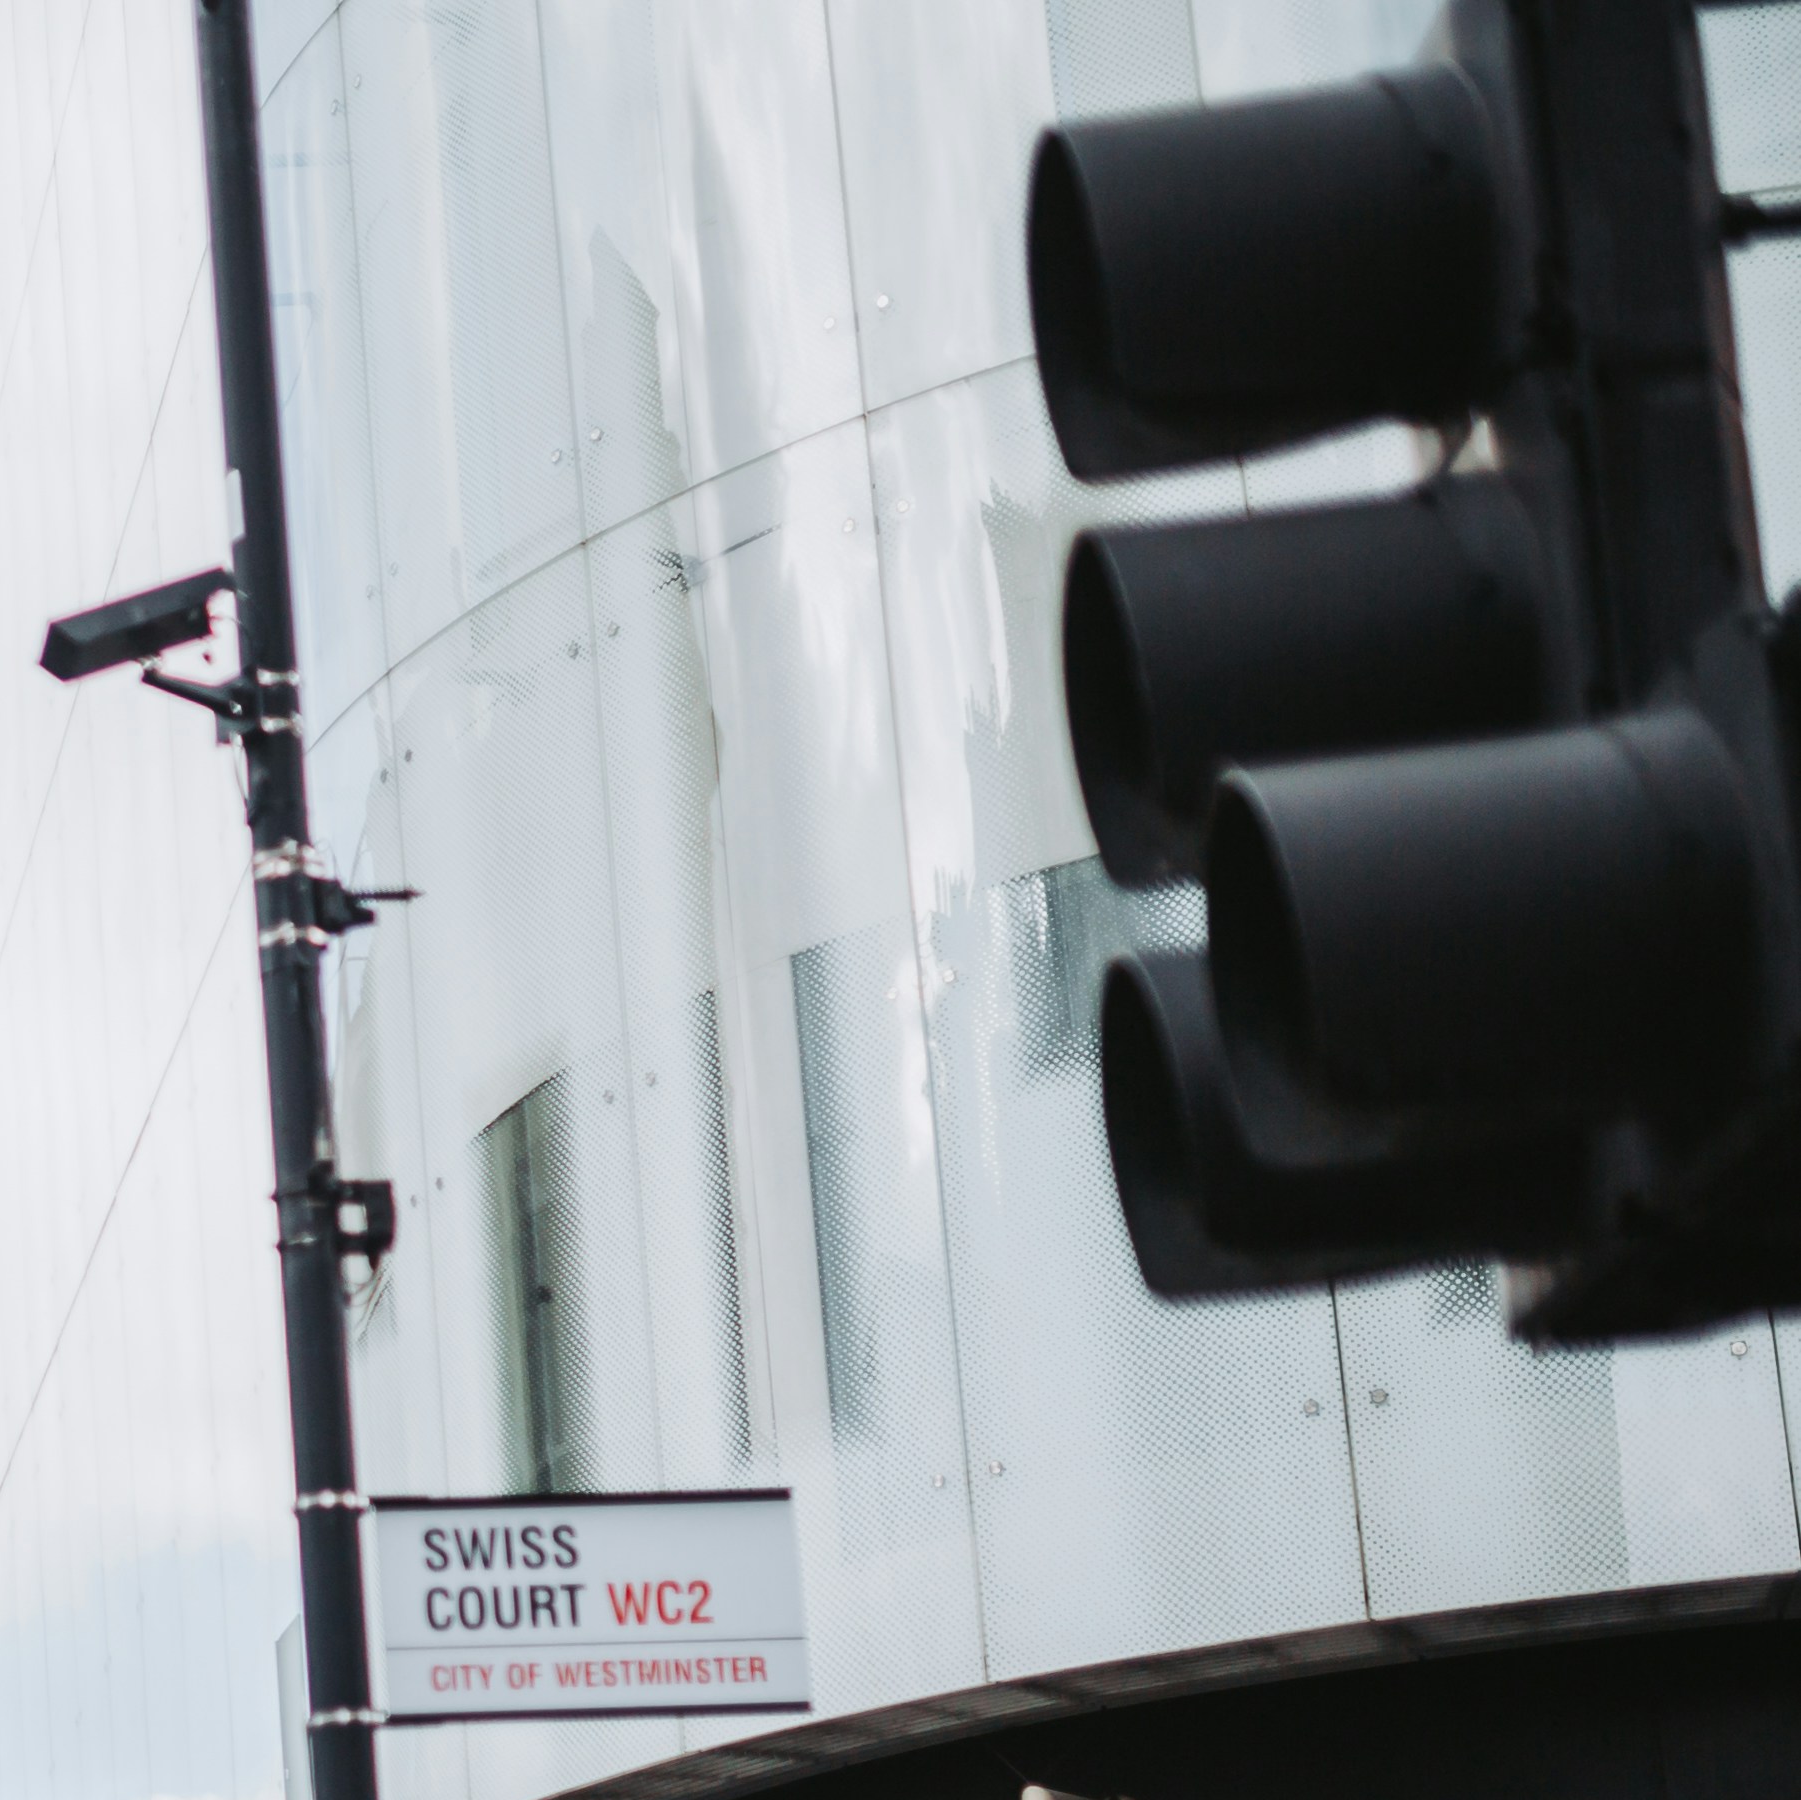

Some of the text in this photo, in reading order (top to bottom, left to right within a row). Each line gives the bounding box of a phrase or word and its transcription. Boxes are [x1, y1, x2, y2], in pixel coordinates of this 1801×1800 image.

[424, 1525, 580, 1571] SWISS
[426, 1580, 715, 1631] COURT WC2
[432, 1656, 768, 1692] CITY OF WESTMINSTER
